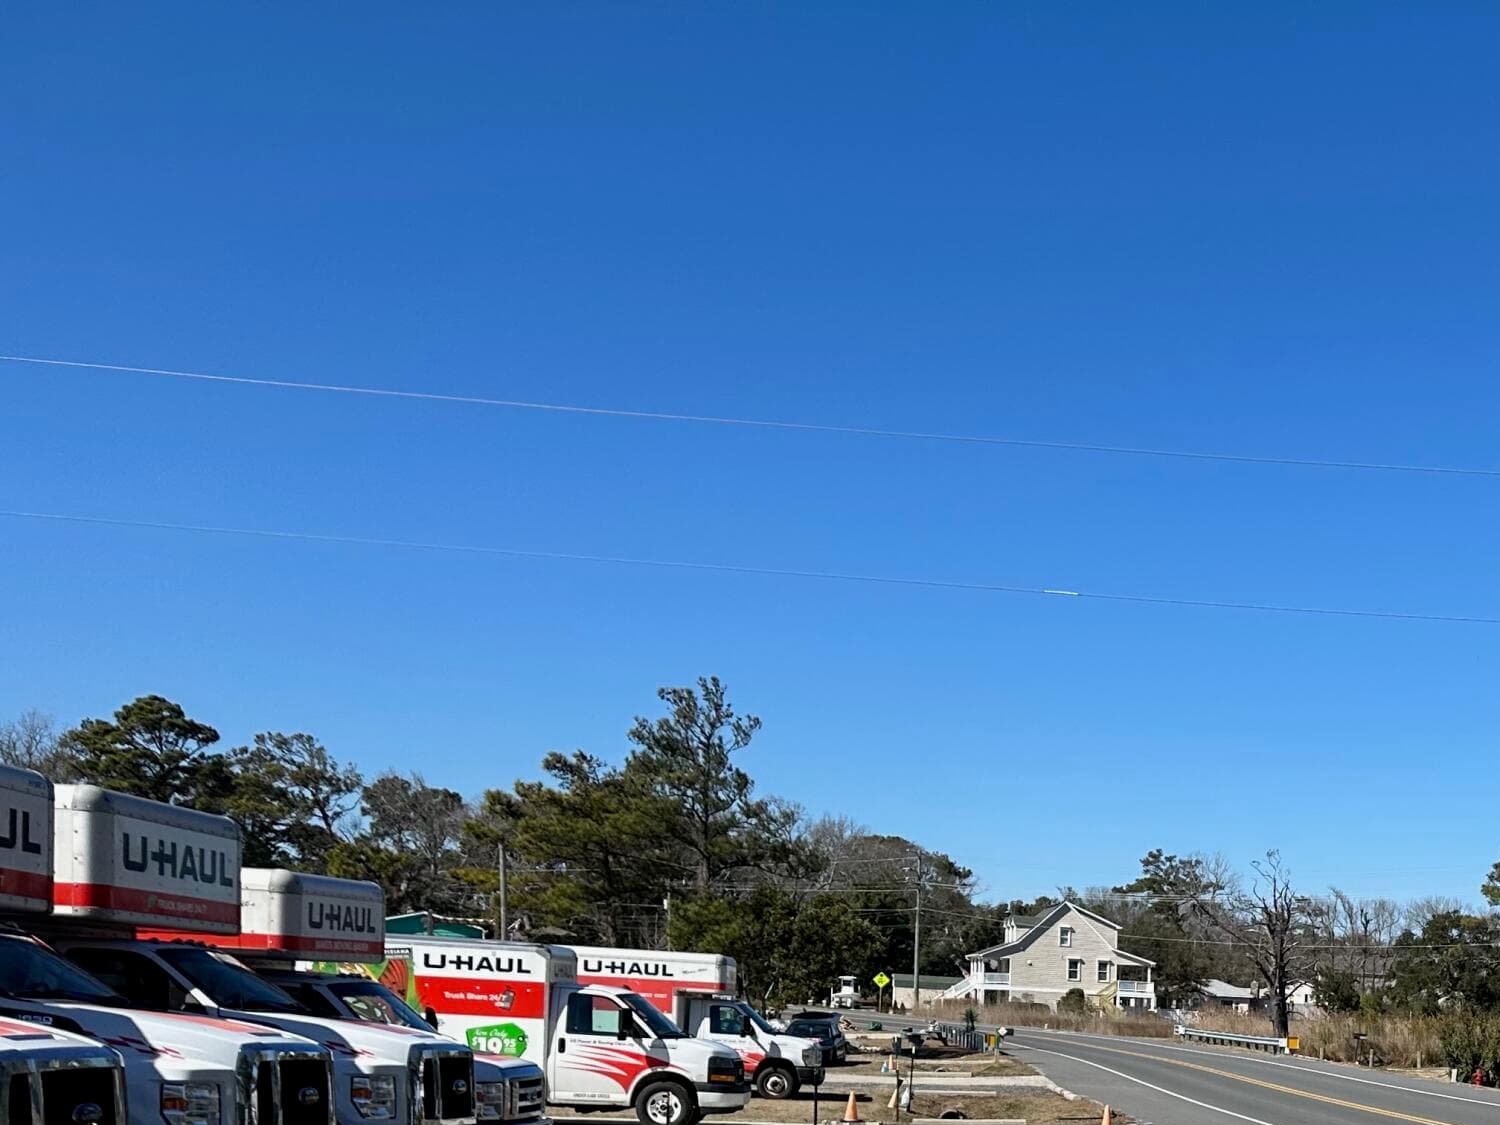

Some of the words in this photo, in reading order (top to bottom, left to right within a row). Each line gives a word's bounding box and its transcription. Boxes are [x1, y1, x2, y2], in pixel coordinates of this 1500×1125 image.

[122, 832, 234, 888] U-HAUL
[308, 902, 377, 934] U-HAUL
[423, 953, 532, 974] U-HAUL
[583, 960, 674, 977] U-HAUL
